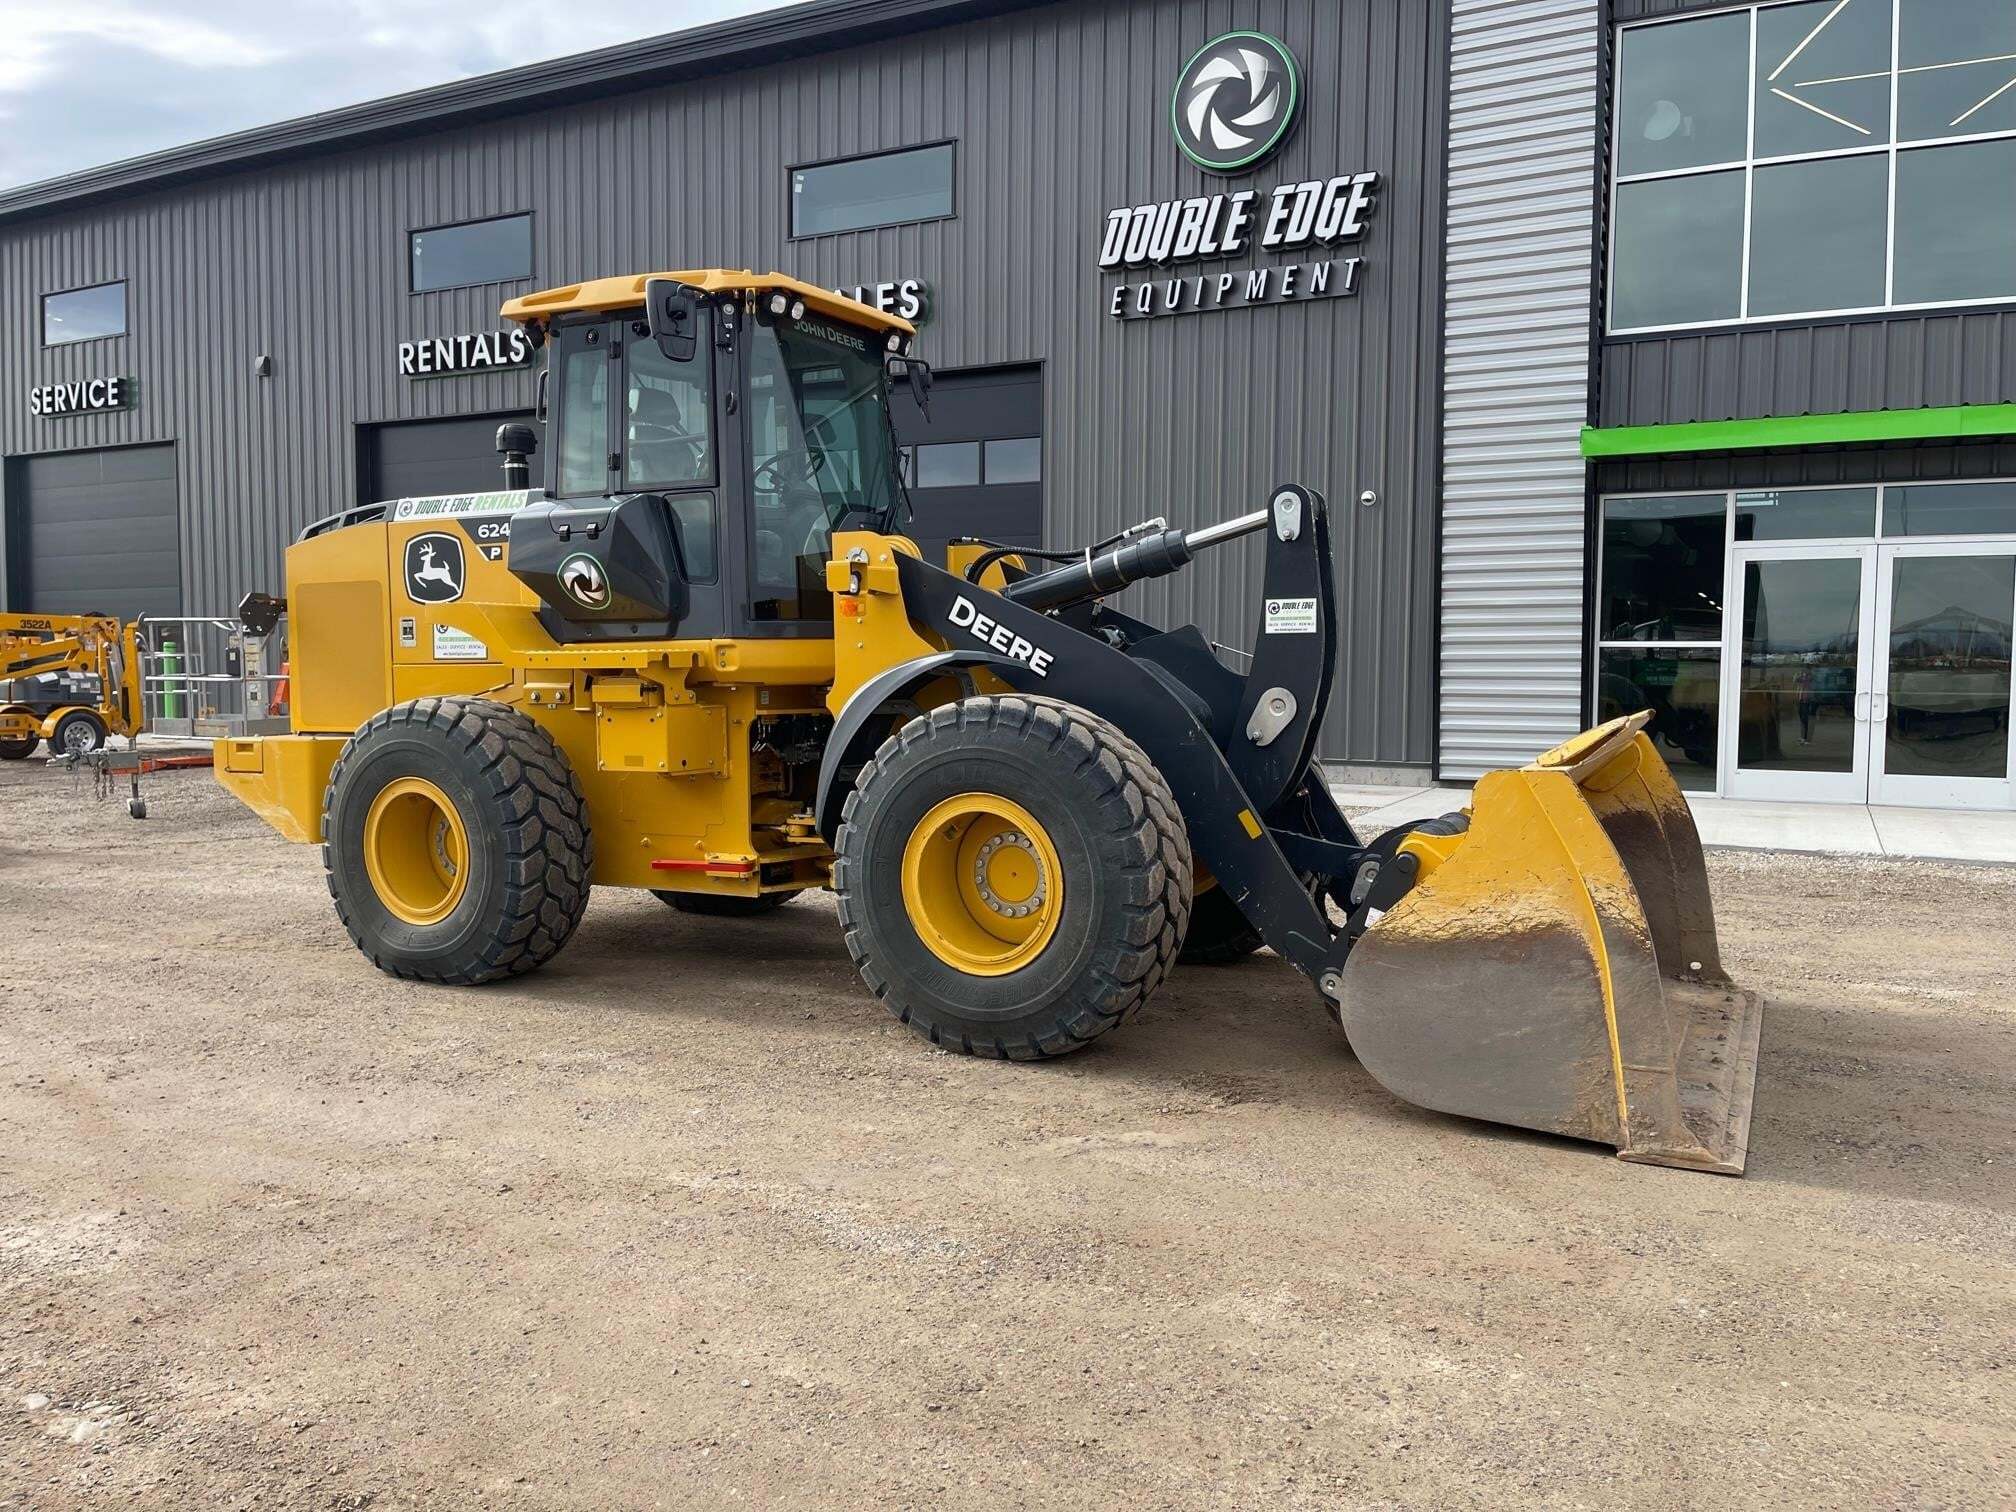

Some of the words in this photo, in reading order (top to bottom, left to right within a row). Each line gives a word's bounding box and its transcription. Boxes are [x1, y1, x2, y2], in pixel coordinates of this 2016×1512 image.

[1099, 190, 1254, 266] DOUBLE
[1262, 171, 1377, 246] EDGE
[1110, 257, 1361, 315] EQUIPMENT
[399, 328, 525, 375] RENTALS
[793, 319, 826, 338] JOHN
[827, 326, 867, 352] DEERE
[31, 377, 119, 416] SERVICE
[414, 498, 449, 515] DOUBLE
[448, 496, 475, 512] EDGE
[473, 490, 527, 512] RENTALS
[477, 522, 511, 539] 624
[490, 547, 501, 560] P
[20, 619, 52, 630] 3522A
[948, 594, 1055, 678] DEERE
